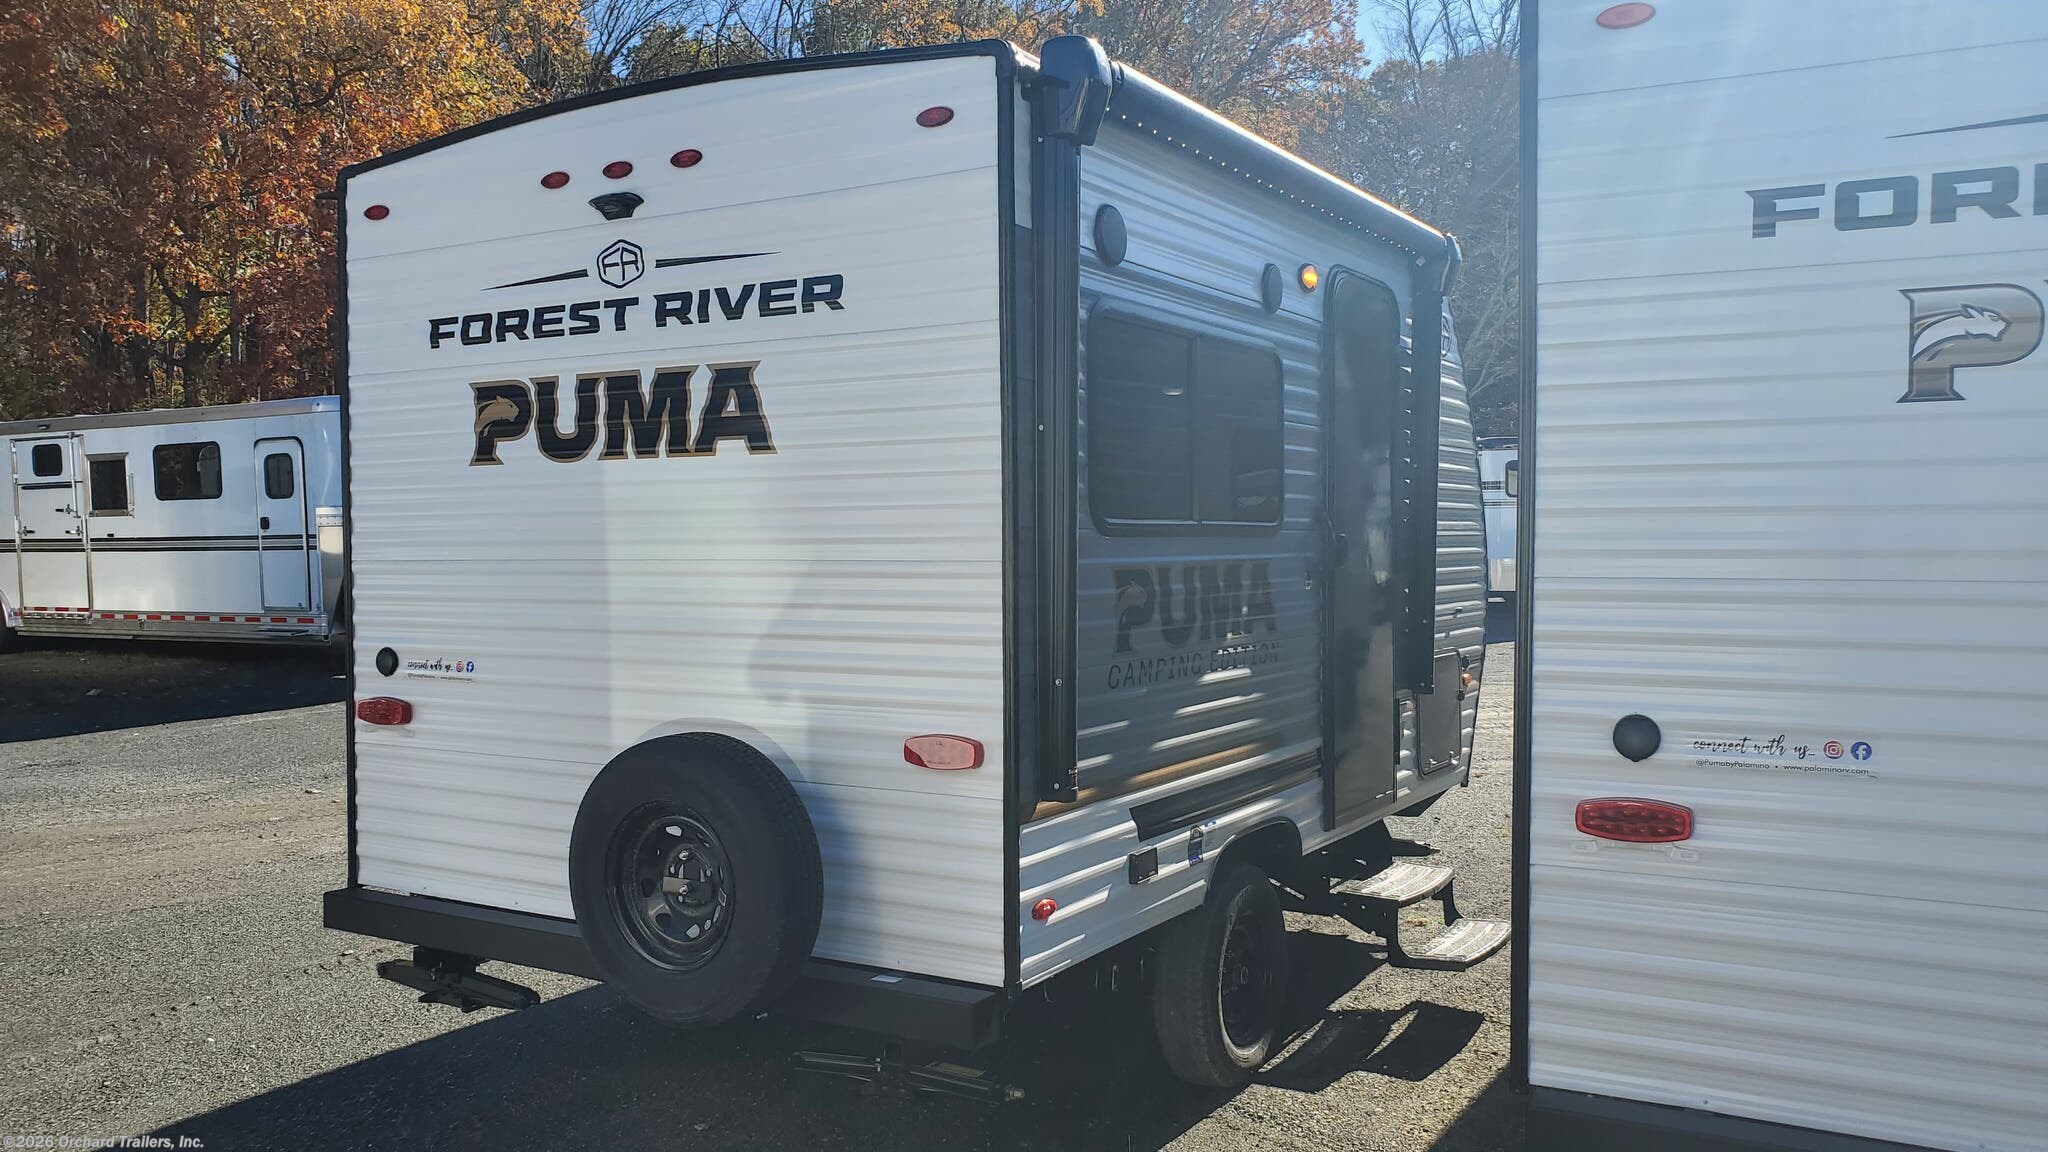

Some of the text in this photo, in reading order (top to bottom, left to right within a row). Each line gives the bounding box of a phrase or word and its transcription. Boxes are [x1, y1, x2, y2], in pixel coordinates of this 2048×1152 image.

[1744, 163, 2048, 238] FOR
[428, 274, 845, 349] FOREST RIVER
[469, 360, 778, 467] PUMA
[1112, 558, 1278, 655] PUMA
[1108, 652, 1203, 690] CAMPING
[1693, 736, 1751, 754] connect
[1753, 734, 1787, 757] with
